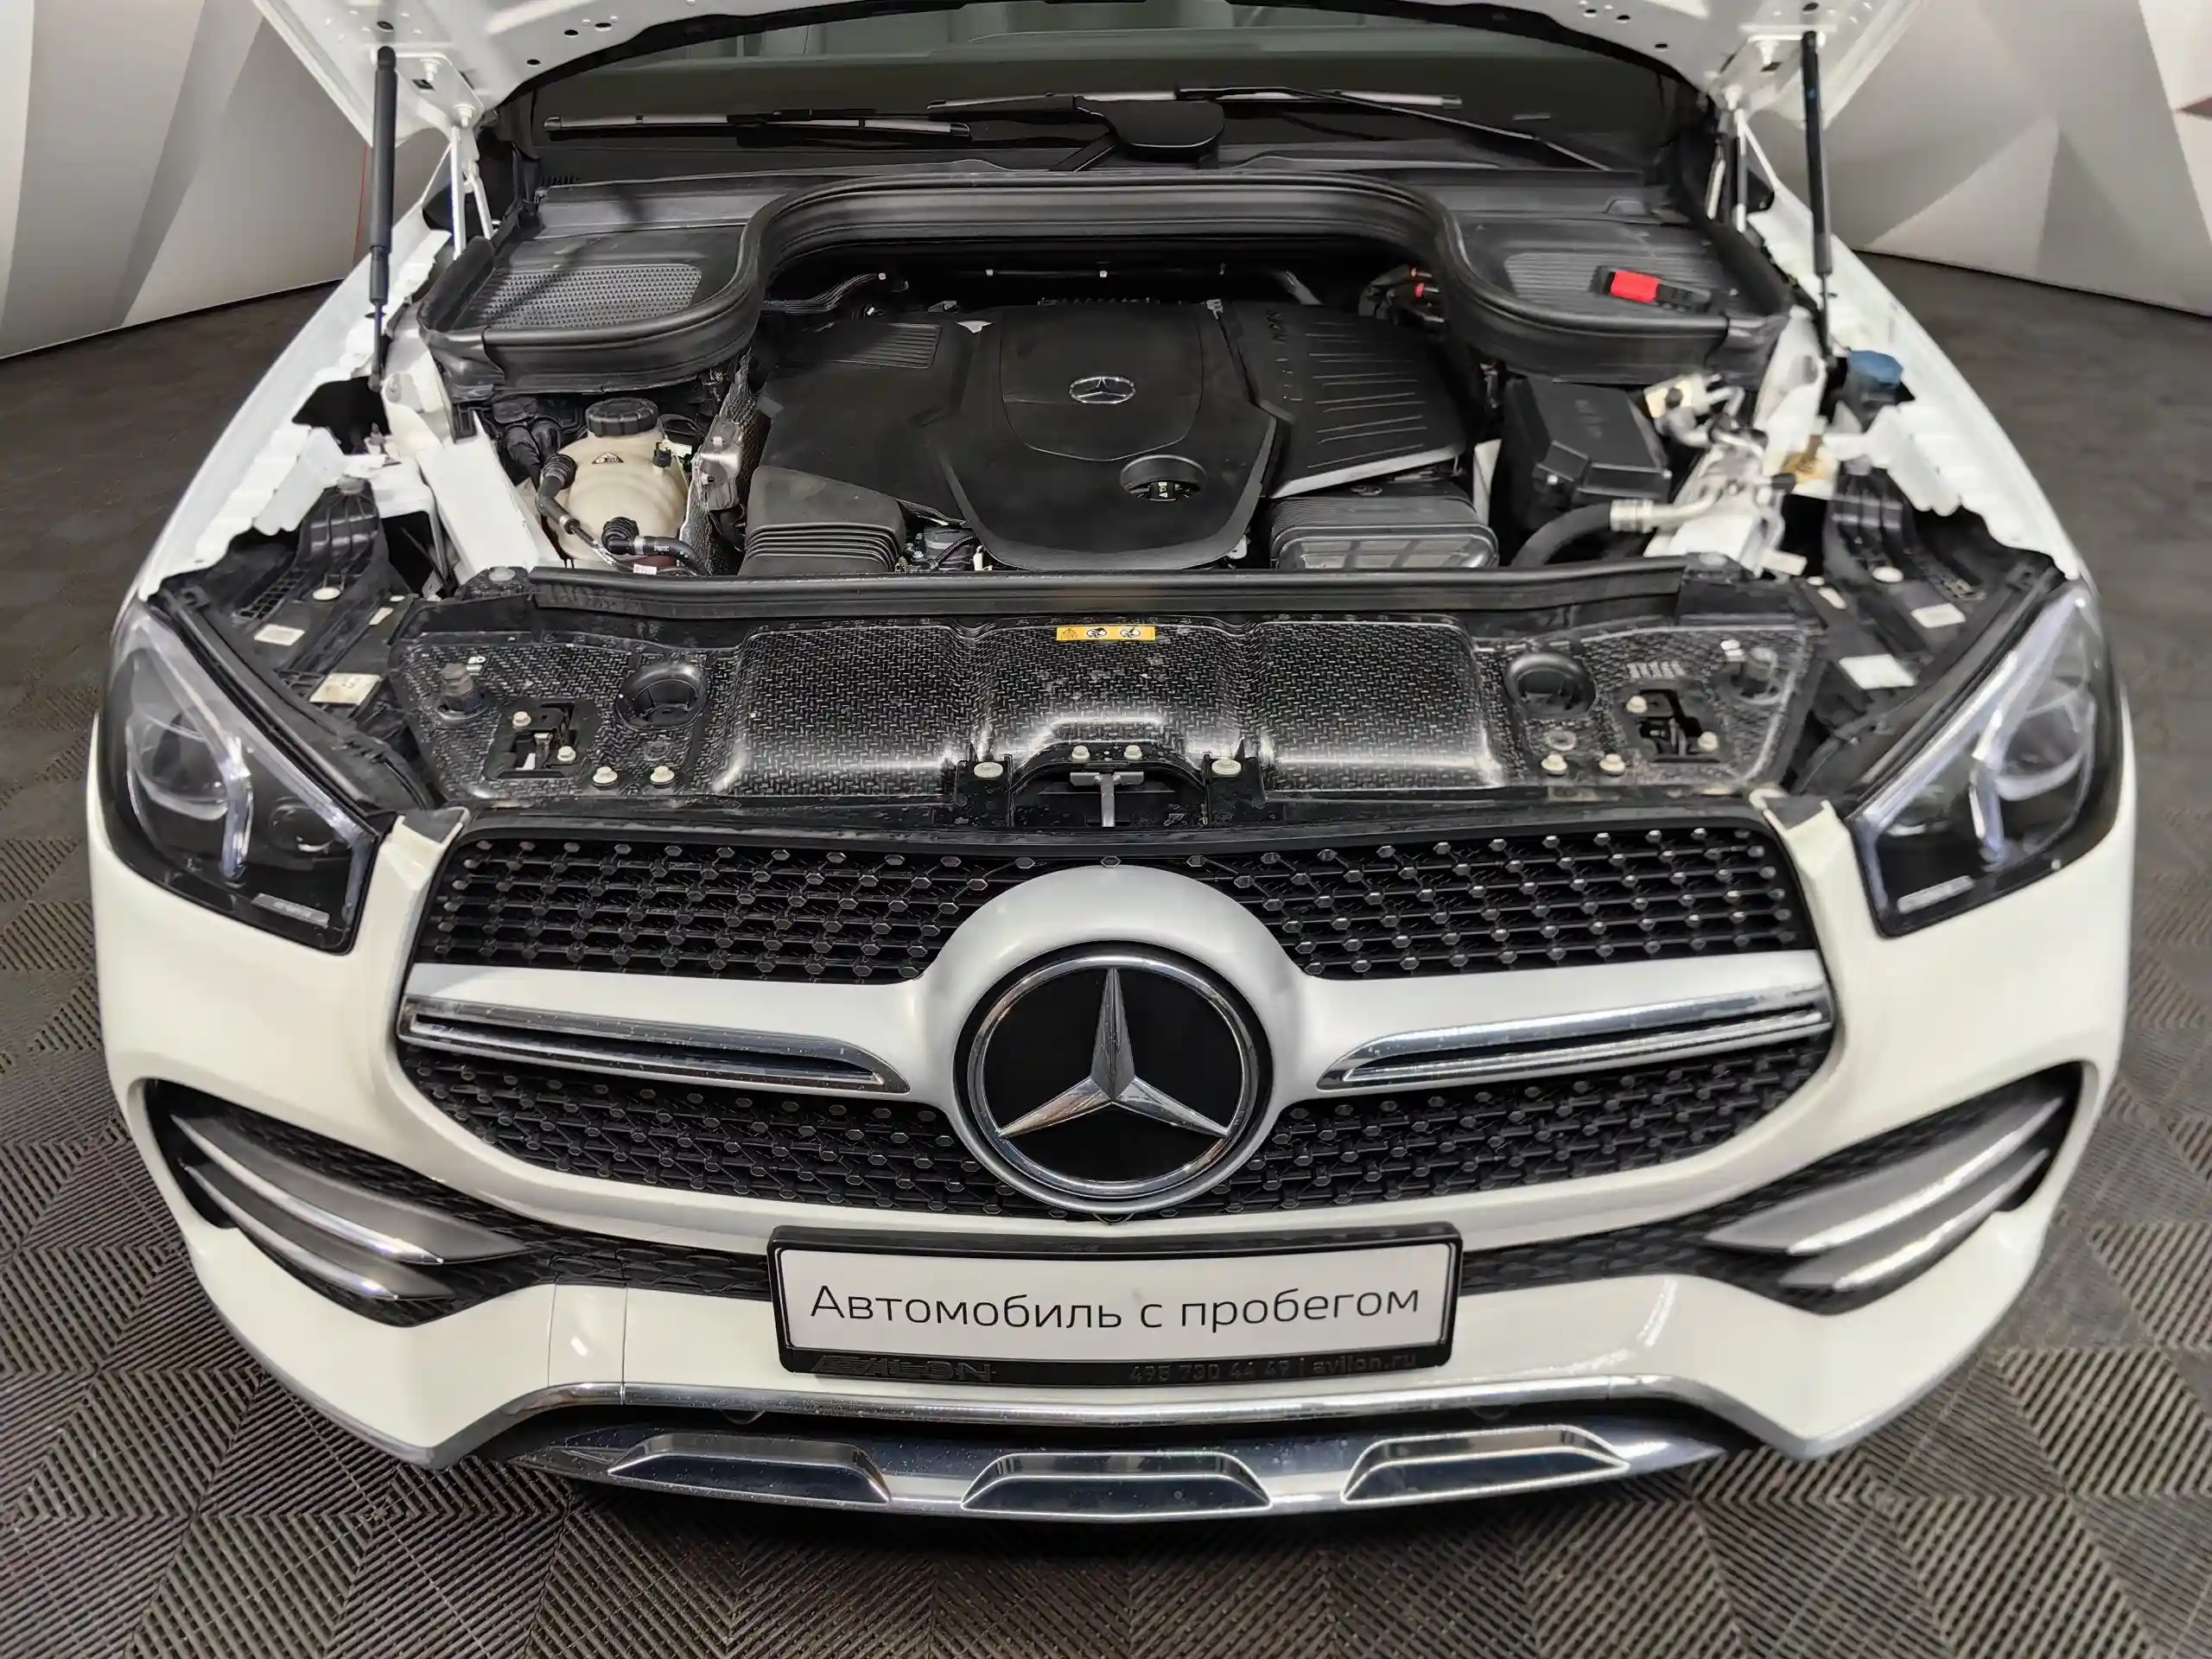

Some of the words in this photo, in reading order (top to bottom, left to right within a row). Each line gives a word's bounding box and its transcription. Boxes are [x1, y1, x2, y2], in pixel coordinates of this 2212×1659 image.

[810, 1284, 1123, 1329] Автомобиль
[1140, 1303, 1163, 1328] с
[1181, 1287, 1420, 1334] пробегом
[1129, 1364, 1171, 1382] 495
[1178, 1363, 1220, 1381] 730
[1312, 1352, 1417, 1375] avilon.ru
